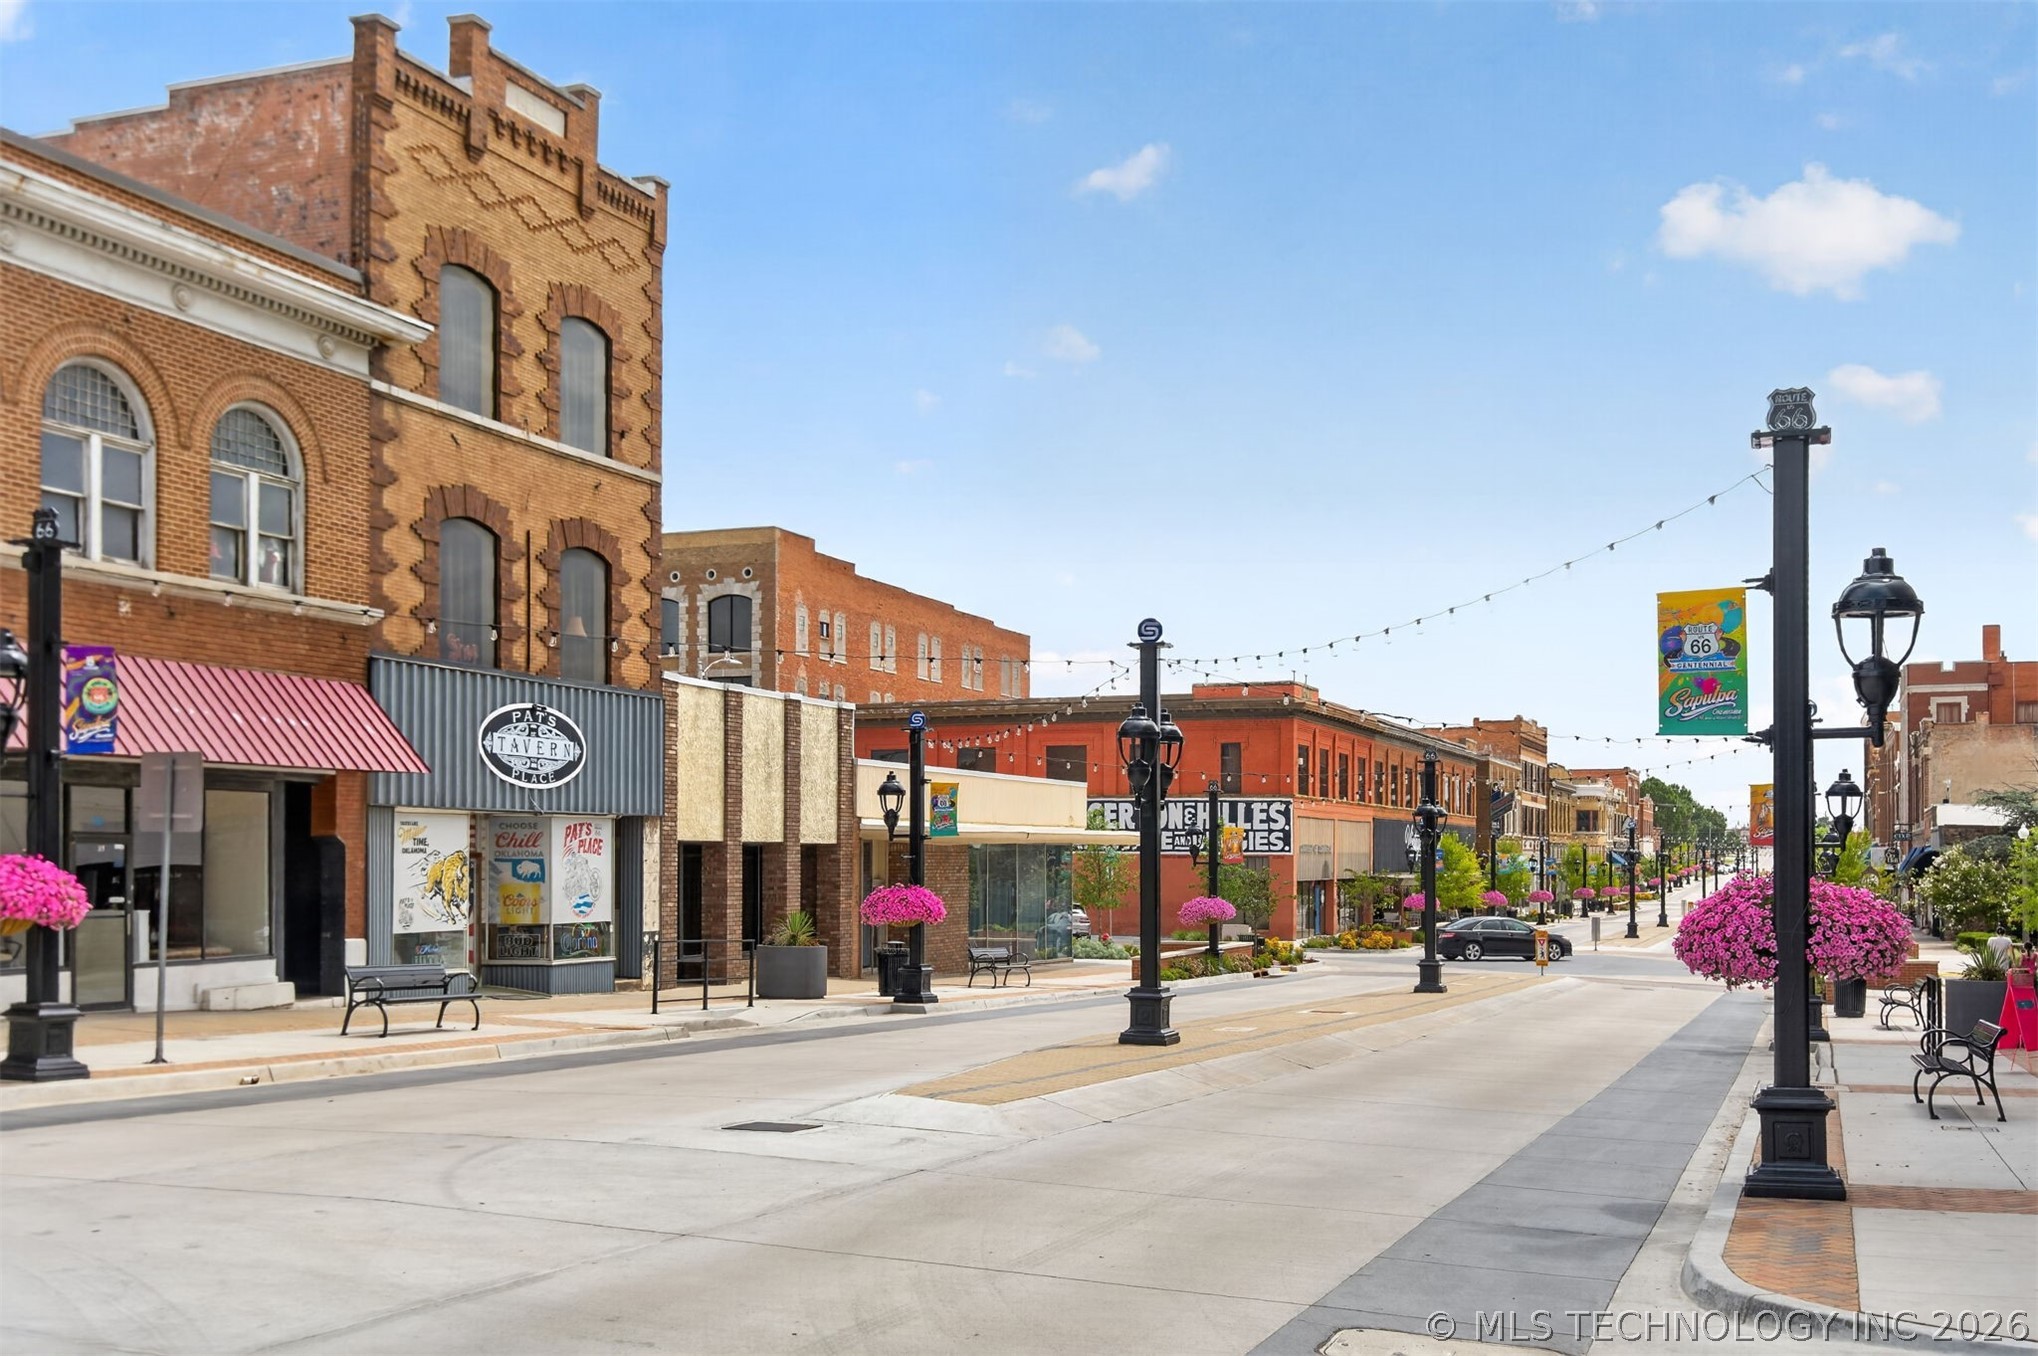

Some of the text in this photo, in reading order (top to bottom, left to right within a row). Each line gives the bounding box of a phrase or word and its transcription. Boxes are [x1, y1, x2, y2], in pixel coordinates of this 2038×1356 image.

[1774, 392, 1808, 403] ROUTE
[1774, 408, 1808, 430] 66
[36, 523, 54, 538] 66
[1687, 625, 1713, 633] ROUTE
[1690, 638, 1712, 655] 66
[1676, 661, 1728, 670] CENTENNIAL
[1665, 684, 1738, 717] Sapulpa
[512, 710, 557, 728] PAT'S
[497, 736, 572, 758] TAVERN
[512, 768, 556, 784] PLACE
[1087, 802, 1183, 830] ERN
[1196, 802, 1289, 830] HLLES.
[499, 822, 538, 831] CHOOSE
[495, 831, 544, 849] Chill
[564, 821, 593, 849] PAT'S
[494, 850, 544, 858] OKLAHOMA
[578, 838, 604, 856] PLACE
[503, 895, 538, 907] Coors
[506, 907, 534, 915] LIGHT
[504, 935, 534, 947] BUD
[561, 931, 598, 952] Corona
[500, 945, 539, 958] LIGHT
